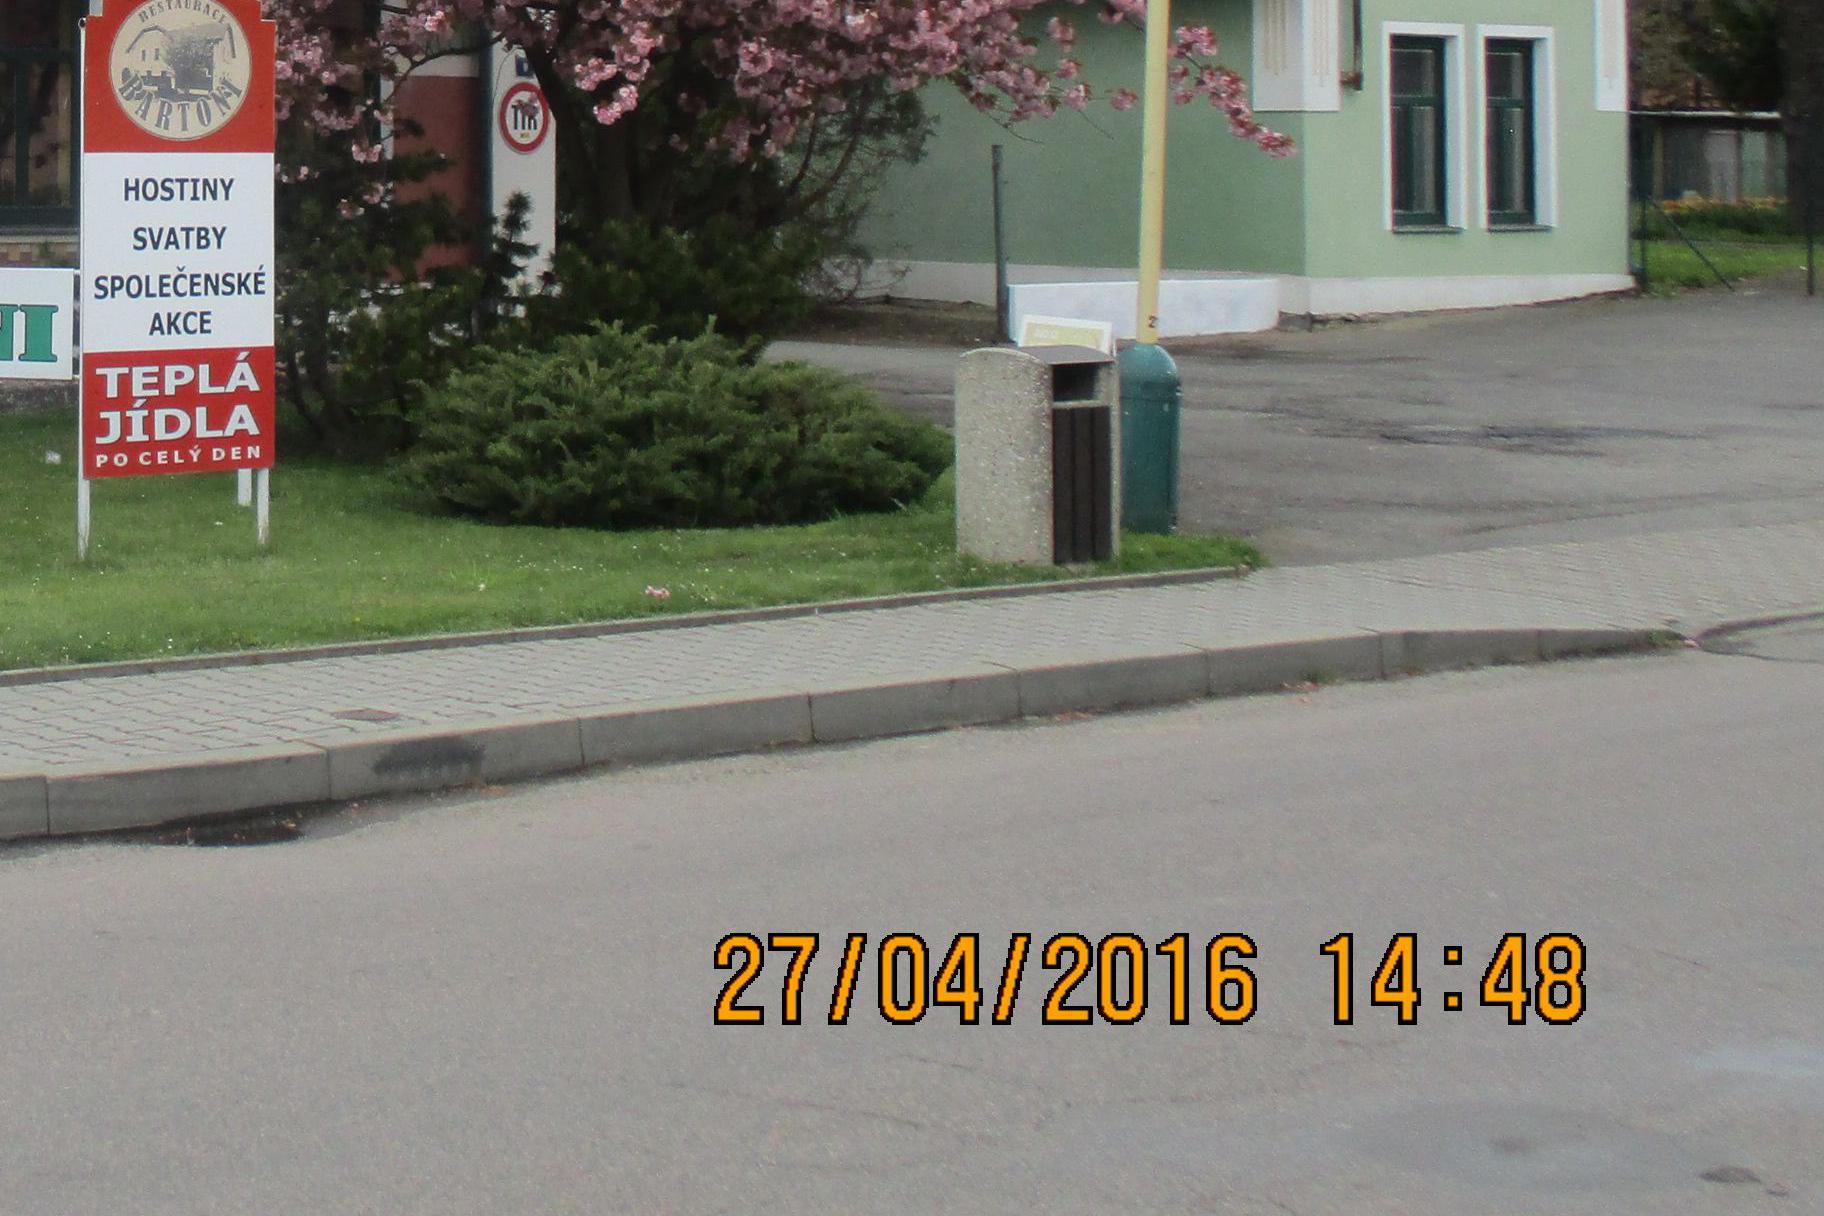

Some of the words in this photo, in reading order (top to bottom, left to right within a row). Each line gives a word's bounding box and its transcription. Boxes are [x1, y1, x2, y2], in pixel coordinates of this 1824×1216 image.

[123, 177, 235, 202] HOSTINY
[132, 226, 227, 251] SVATBY
[93, 264, 267, 300] SPOLEČENSKÉ
[148, 310, 212, 336] AKCE
[95, 350, 262, 399] TEPLÁ
[95, 398, 261, 445] JÍDLA
[95, 453, 129, 468] PO
[138, 444, 202, 466] CELÝ
[212, 445, 261, 462] DEN
